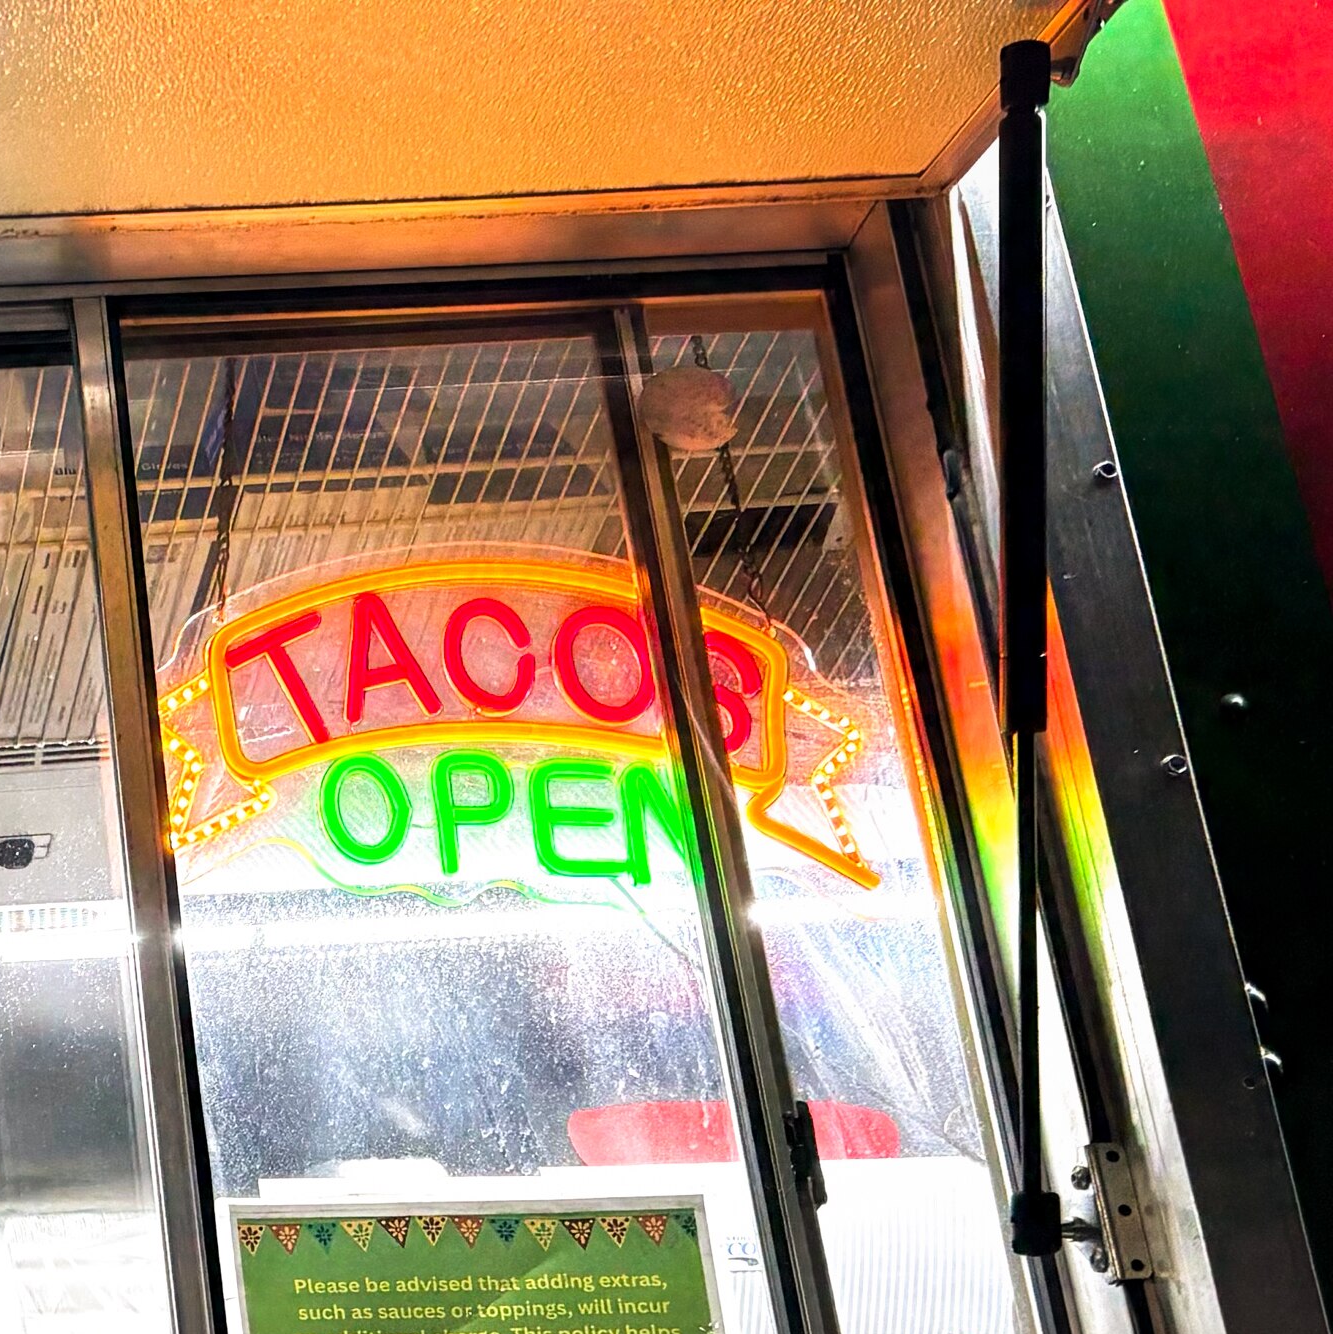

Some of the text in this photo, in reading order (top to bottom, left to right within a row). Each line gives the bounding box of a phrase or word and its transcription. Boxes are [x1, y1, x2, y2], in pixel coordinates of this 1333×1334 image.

[225, 592, 763, 755] TACOS
[294, 1273, 667, 1294] Please be advised that adding extras,
[299, 1298, 670, 1321] such as sauces or toppings, will incur
